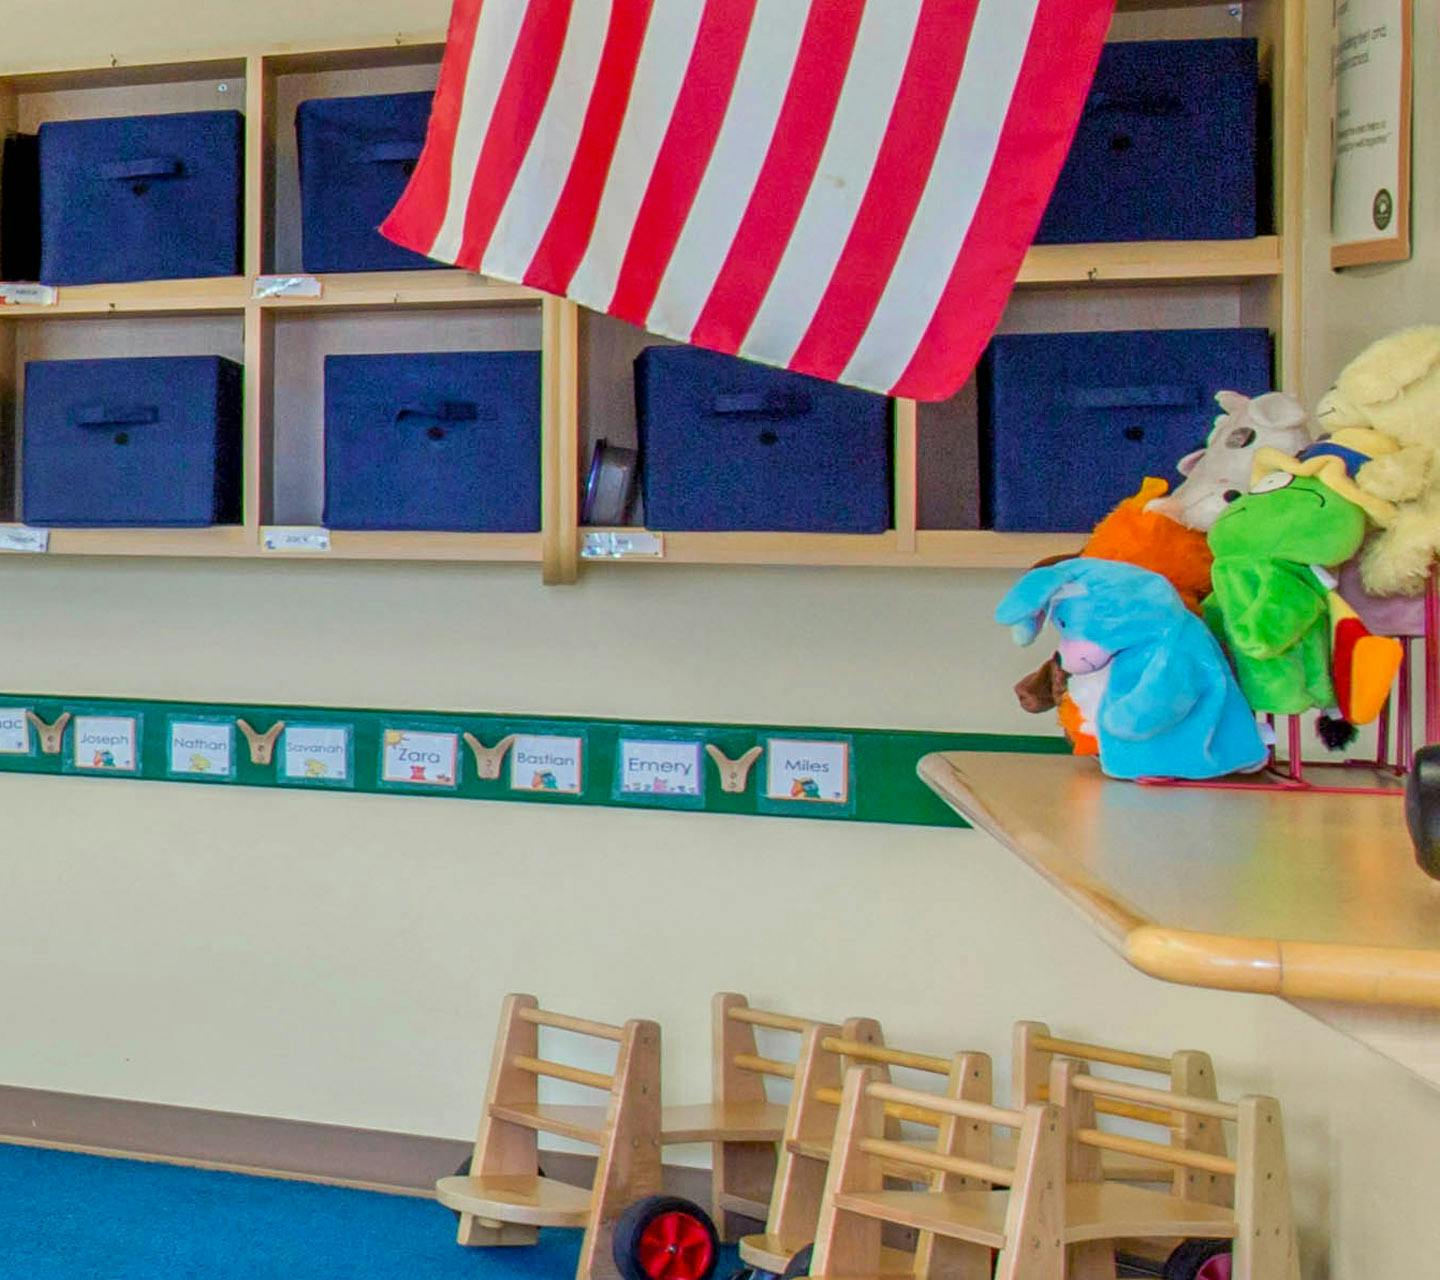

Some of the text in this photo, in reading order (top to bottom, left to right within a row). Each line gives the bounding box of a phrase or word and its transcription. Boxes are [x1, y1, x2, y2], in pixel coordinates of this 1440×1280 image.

[80, 733, 129, 746] Joseph
[174, 737, 227, 751] Nathan
[398, 748, 441, 764] Zara
[517, 752, 575, 766] Bastian
[628, 757, 692, 776] Emery
[785, 759, 830, 773] Miles
